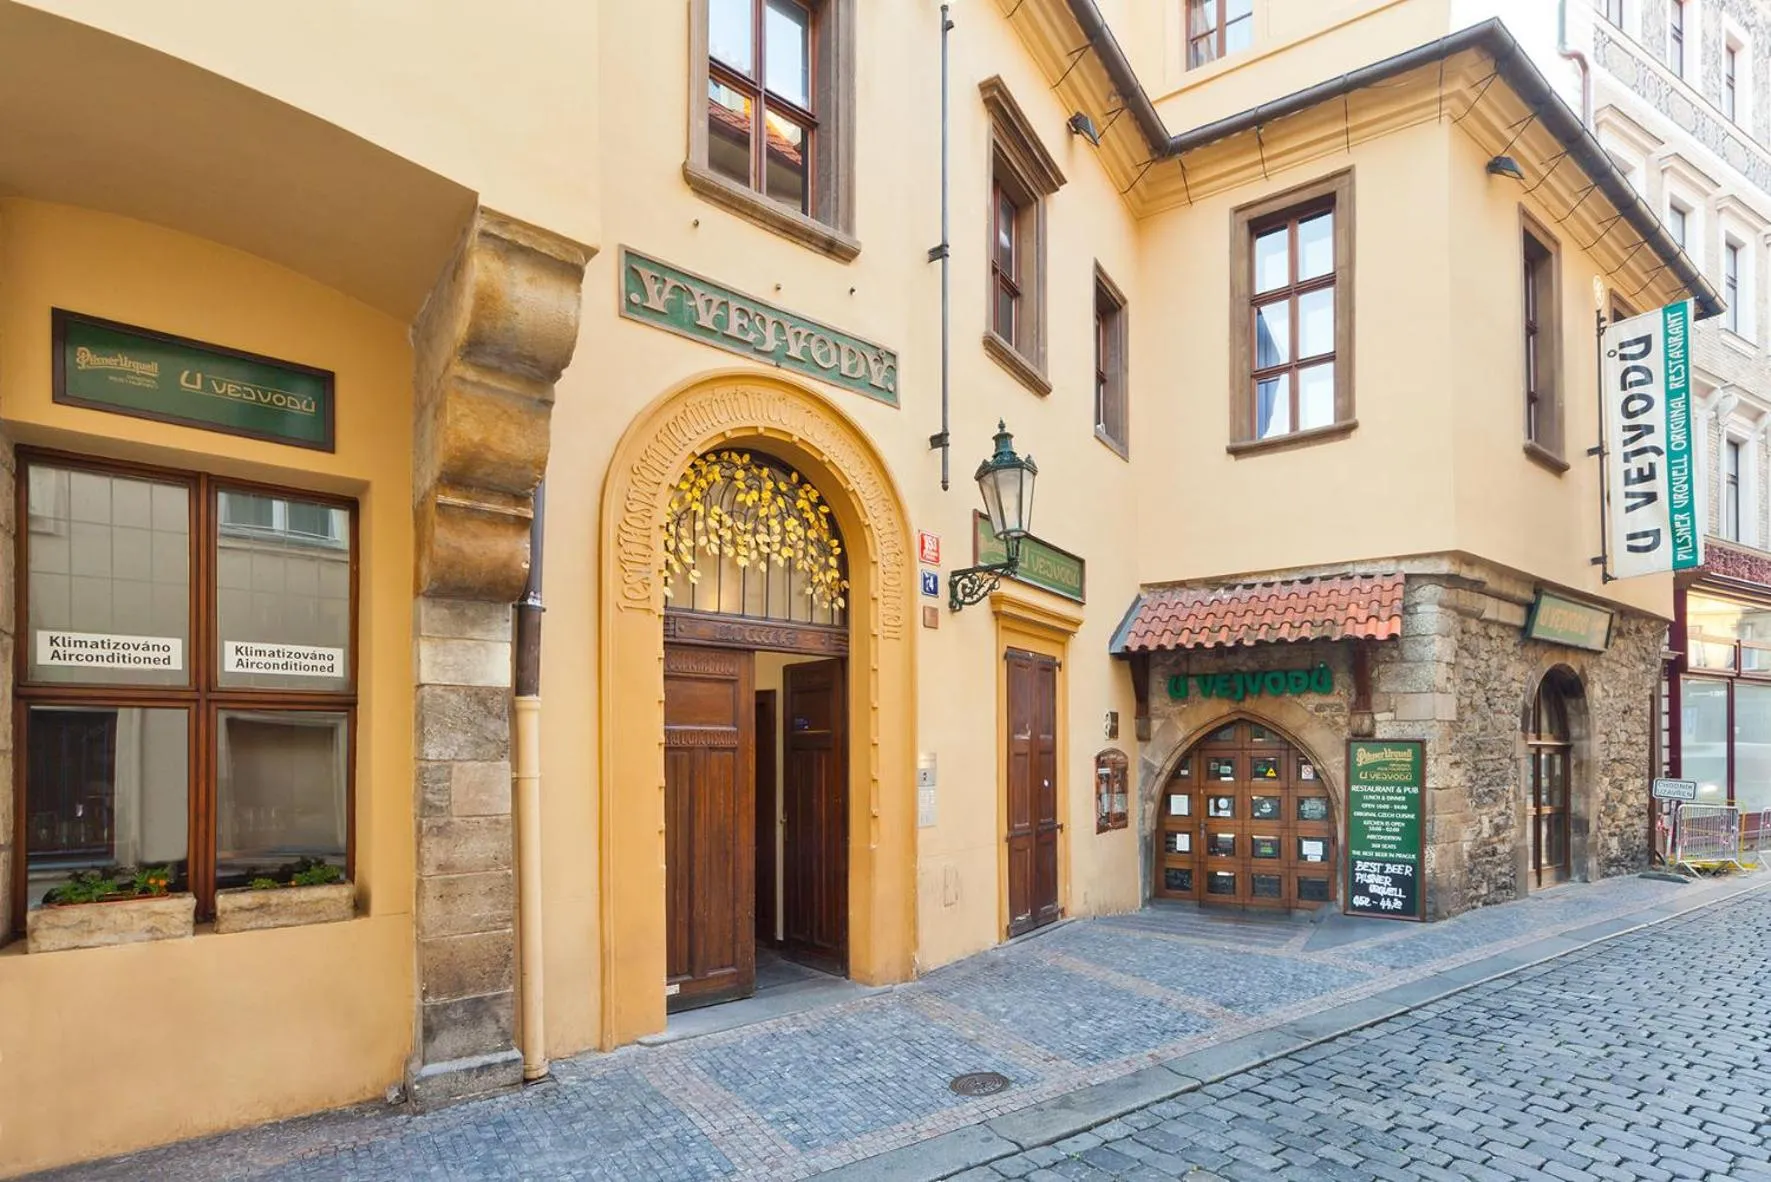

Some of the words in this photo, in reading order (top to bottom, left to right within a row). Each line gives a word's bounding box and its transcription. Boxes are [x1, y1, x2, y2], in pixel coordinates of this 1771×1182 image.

[179, 369, 203, 391] U
[1607, 333, 1665, 515] VEJVODŮ
[1667, 392, 1687, 451] ORIGINAL
[1626, 528, 1661, 554] U
[1673, 513, 1693, 561] PILSNER
[49, 635, 171, 653] Klimatizováno
[49, 649, 172, 666] Airconditioned
[234, 645, 335, 662] Klimatizováno
[235, 659, 335, 674] Airconditioned
[1167, 674, 1189, 700] U
[1195, 661, 1333, 701] VEJVODŮ
[1351, 785, 1395, 793] RESTAURANT
[1403, 786, 1419, 794] PUB
[1355, 861, 1384, 873] BEST
[1384, 863, 1413, 876] BEER
[1355, 873, 1392, 886] PILSNER
[1369, 884, 1406, 898] URQUELL
